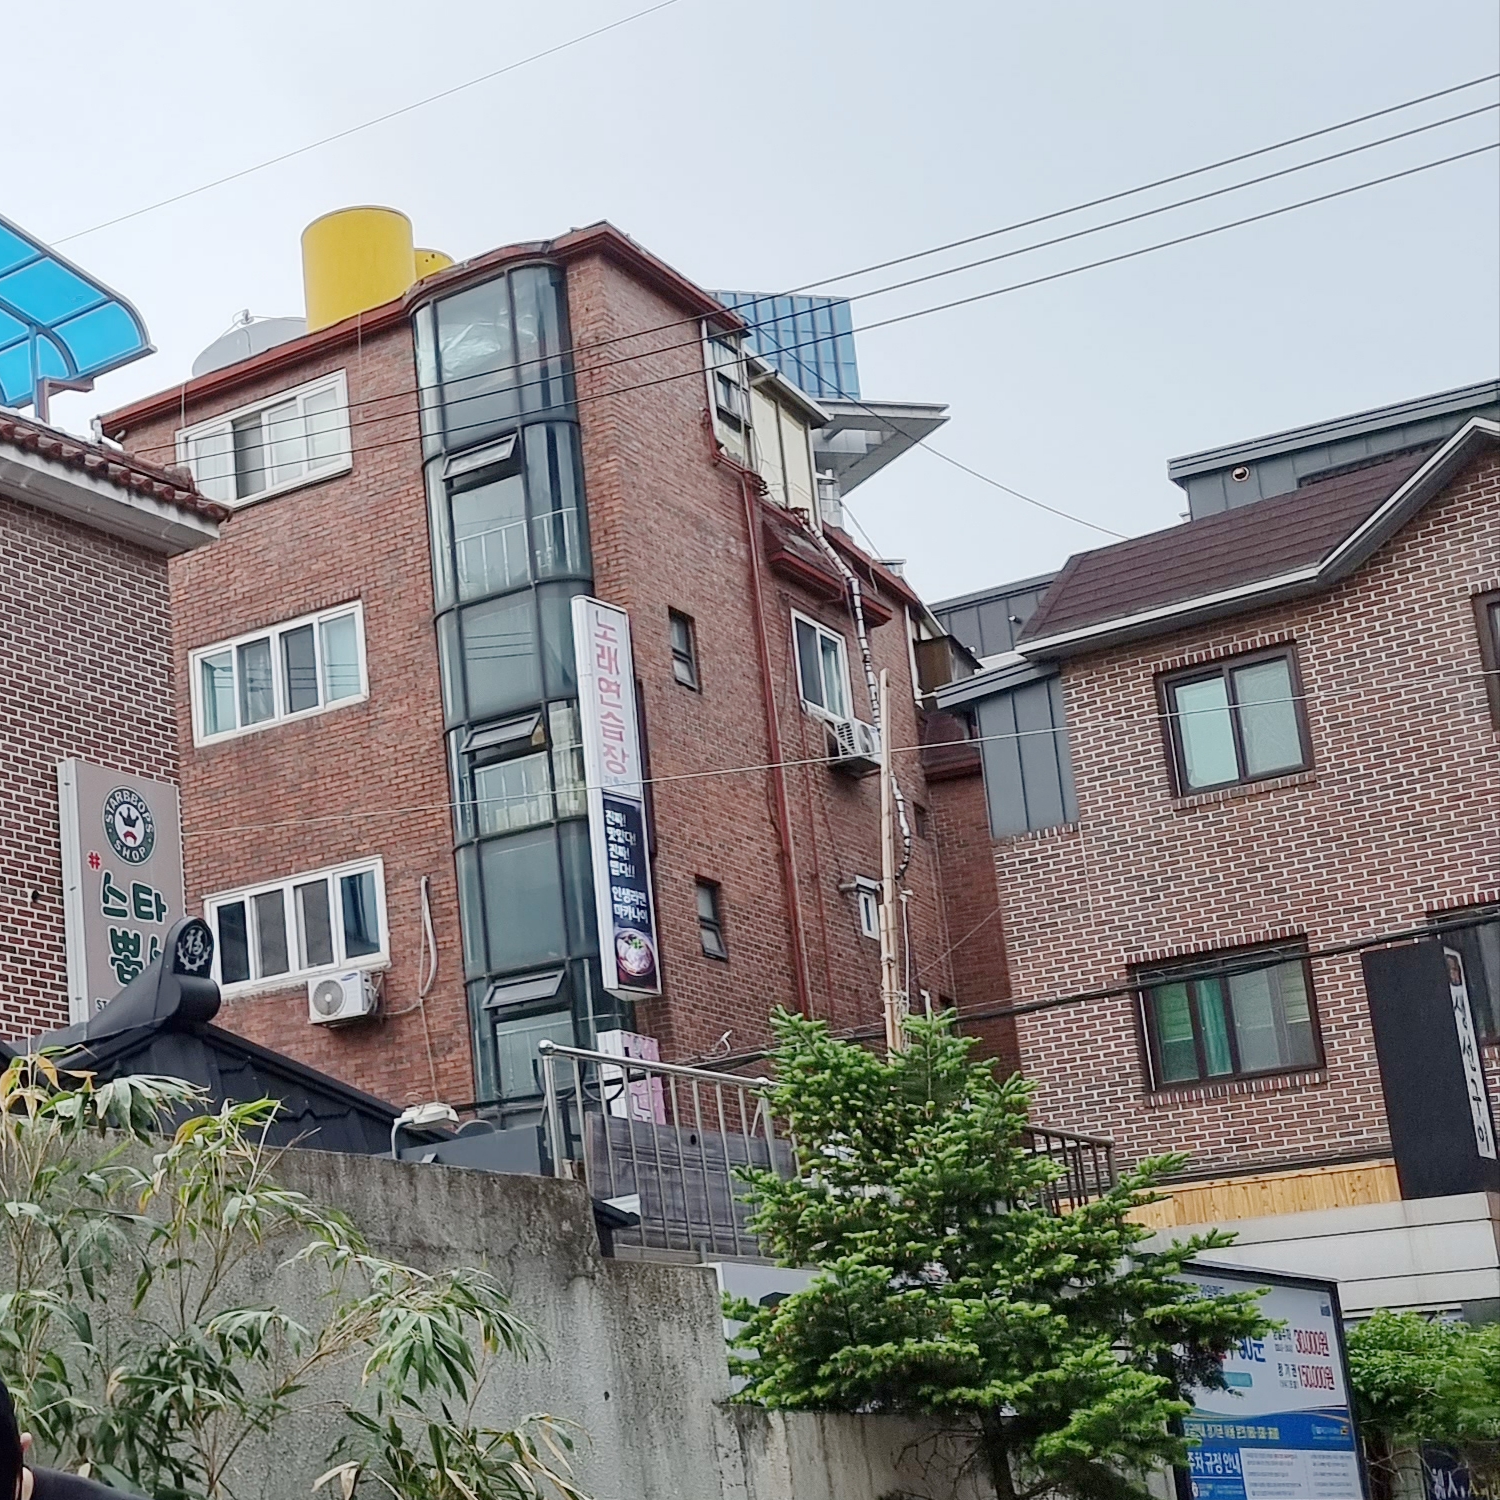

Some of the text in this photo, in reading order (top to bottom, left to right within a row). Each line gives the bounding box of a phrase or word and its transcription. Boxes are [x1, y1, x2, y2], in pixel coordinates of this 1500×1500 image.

[594, 610, 629, 775] 노래연습장
[105, 790, 155, 833] STARBBOPS
[114, 839, 146, 861] SHOP
